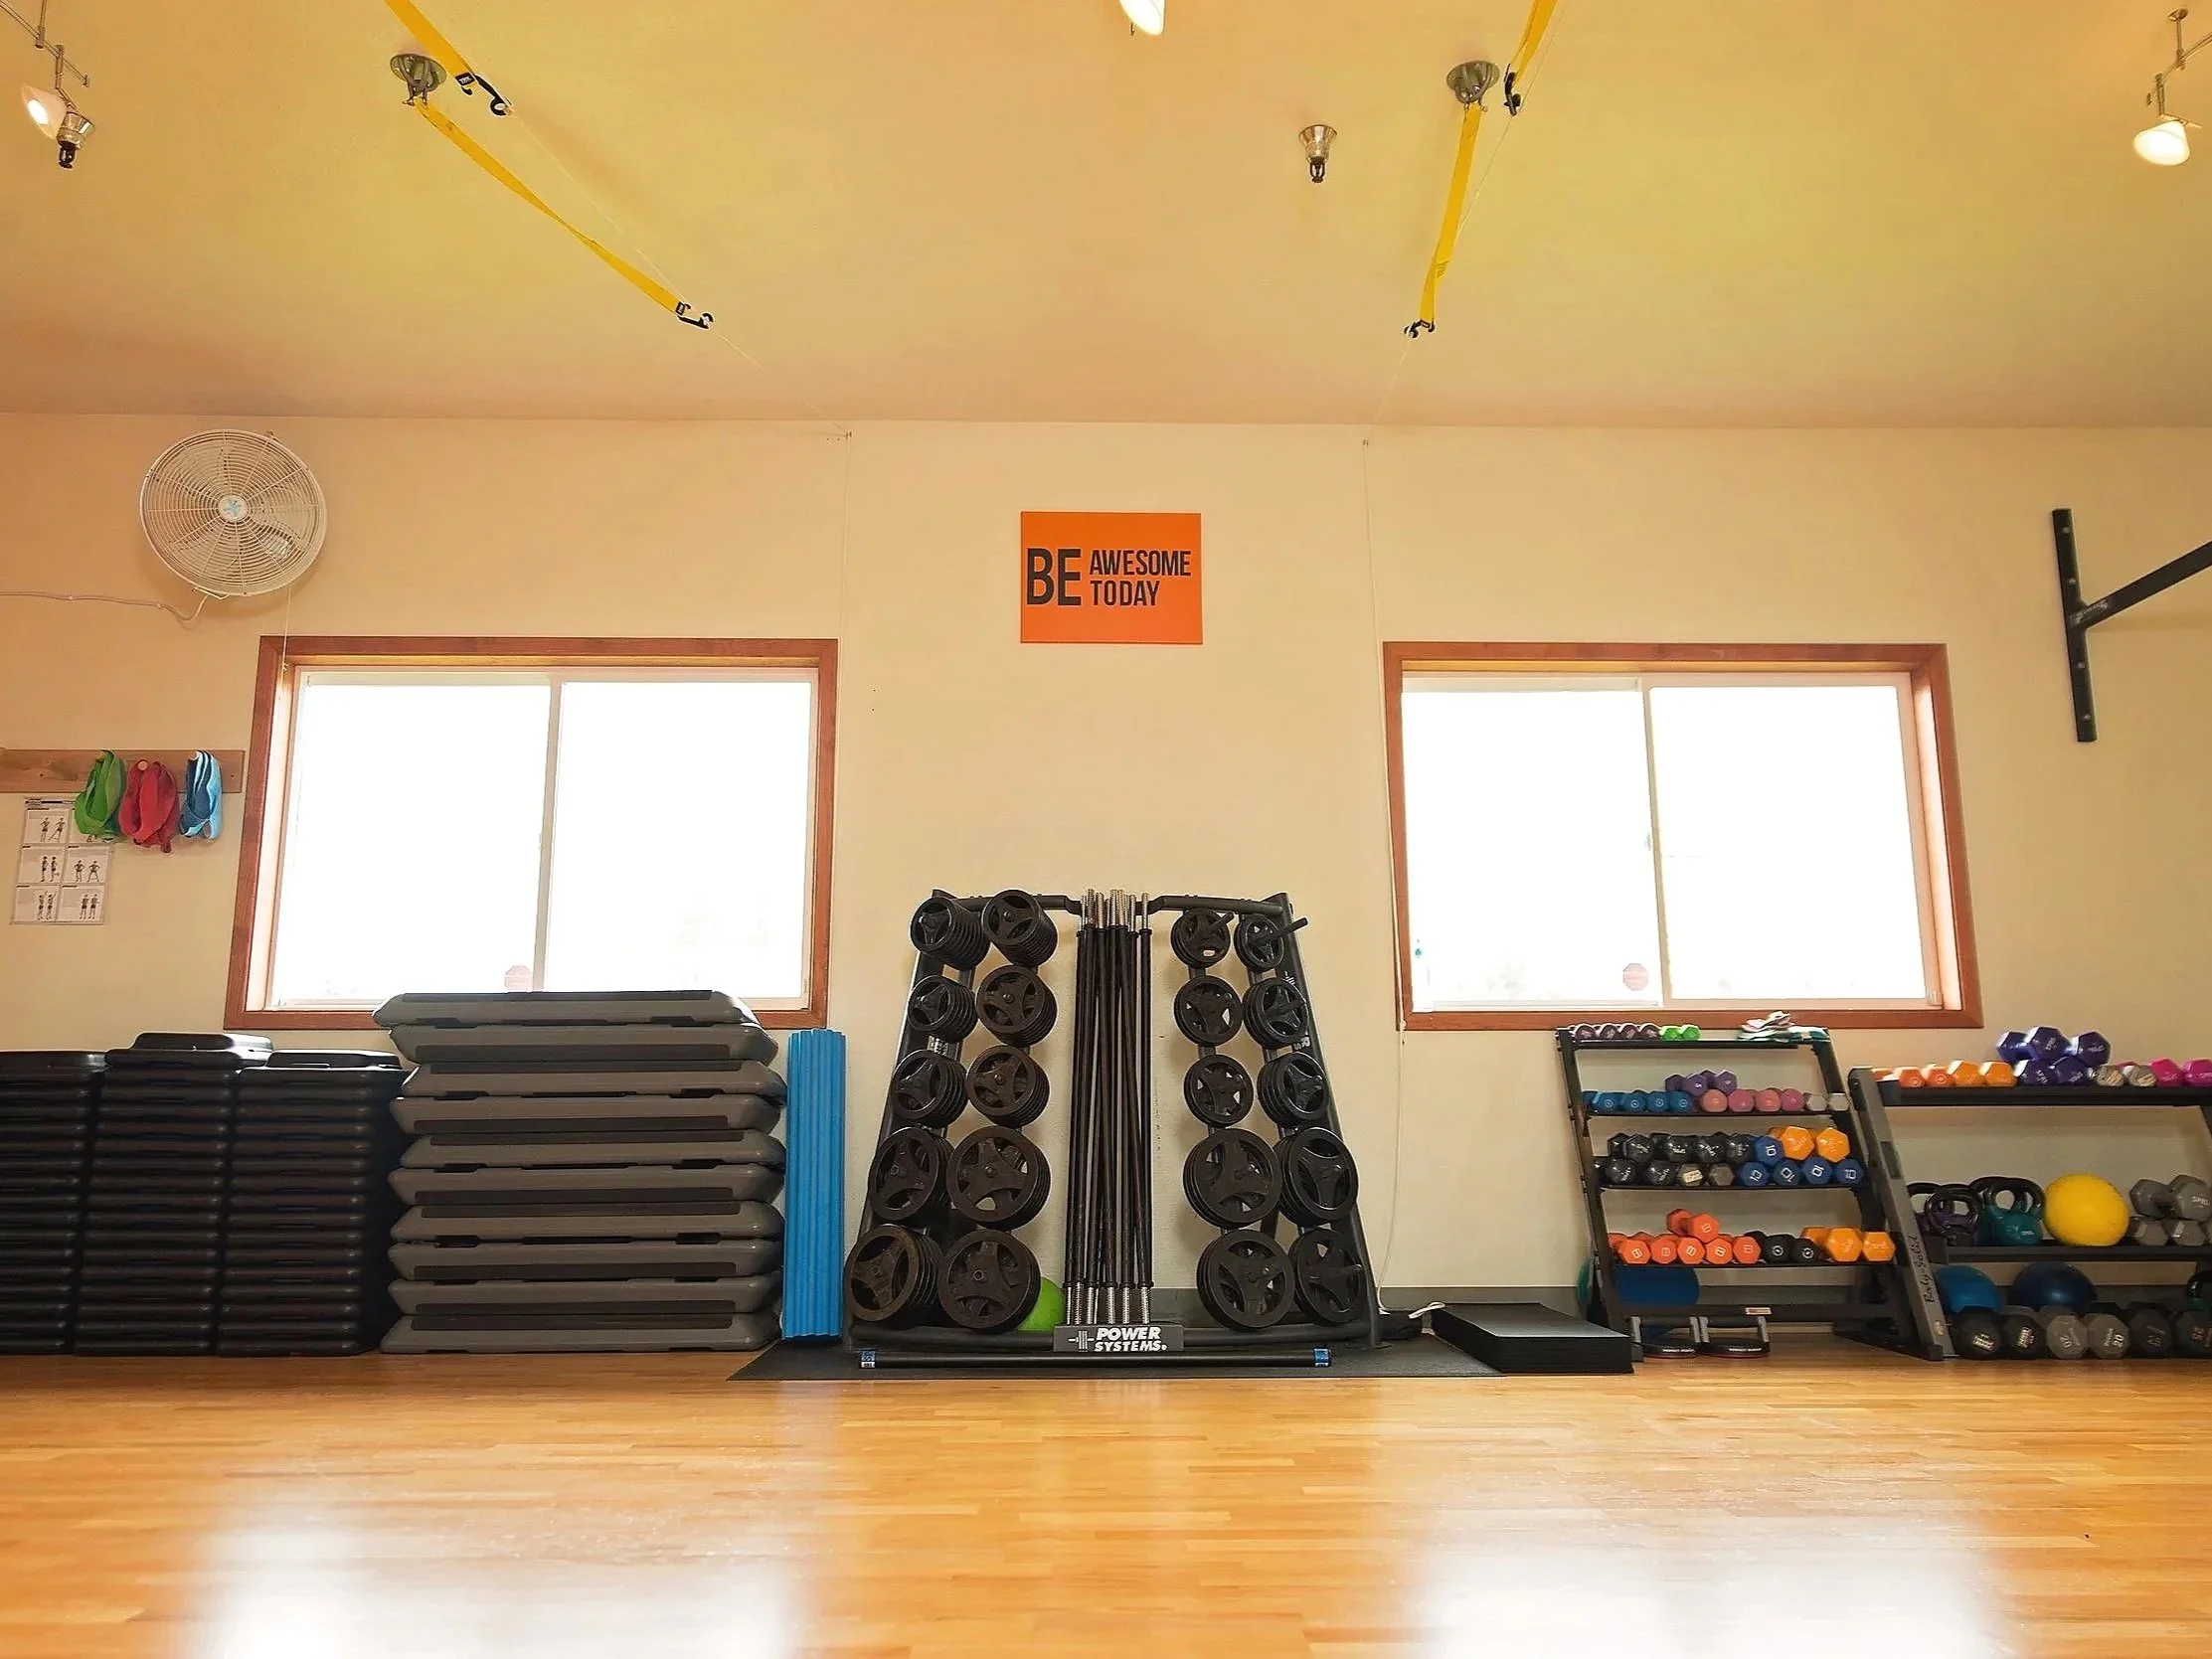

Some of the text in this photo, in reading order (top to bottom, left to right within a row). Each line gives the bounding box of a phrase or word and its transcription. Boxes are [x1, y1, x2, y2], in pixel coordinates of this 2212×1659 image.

[1090, 549, 1192, 577] AWESOME
[1026, 548, 1082, 606] BE
[1090, 580, 1161, 606] TODAY
[1766, 1144, 1778, 1157] 10
[1750, 1169, 1763, 1182] 10
[1781, 1167, 1795, 1183] 10
[1811, 1164, 1824, 1178] 10
[1844, 1169, 1857, 1180] 10
[1096, 1326, 1162, 1341] POWER
[2112, 1333, 2126, 1348] 20
